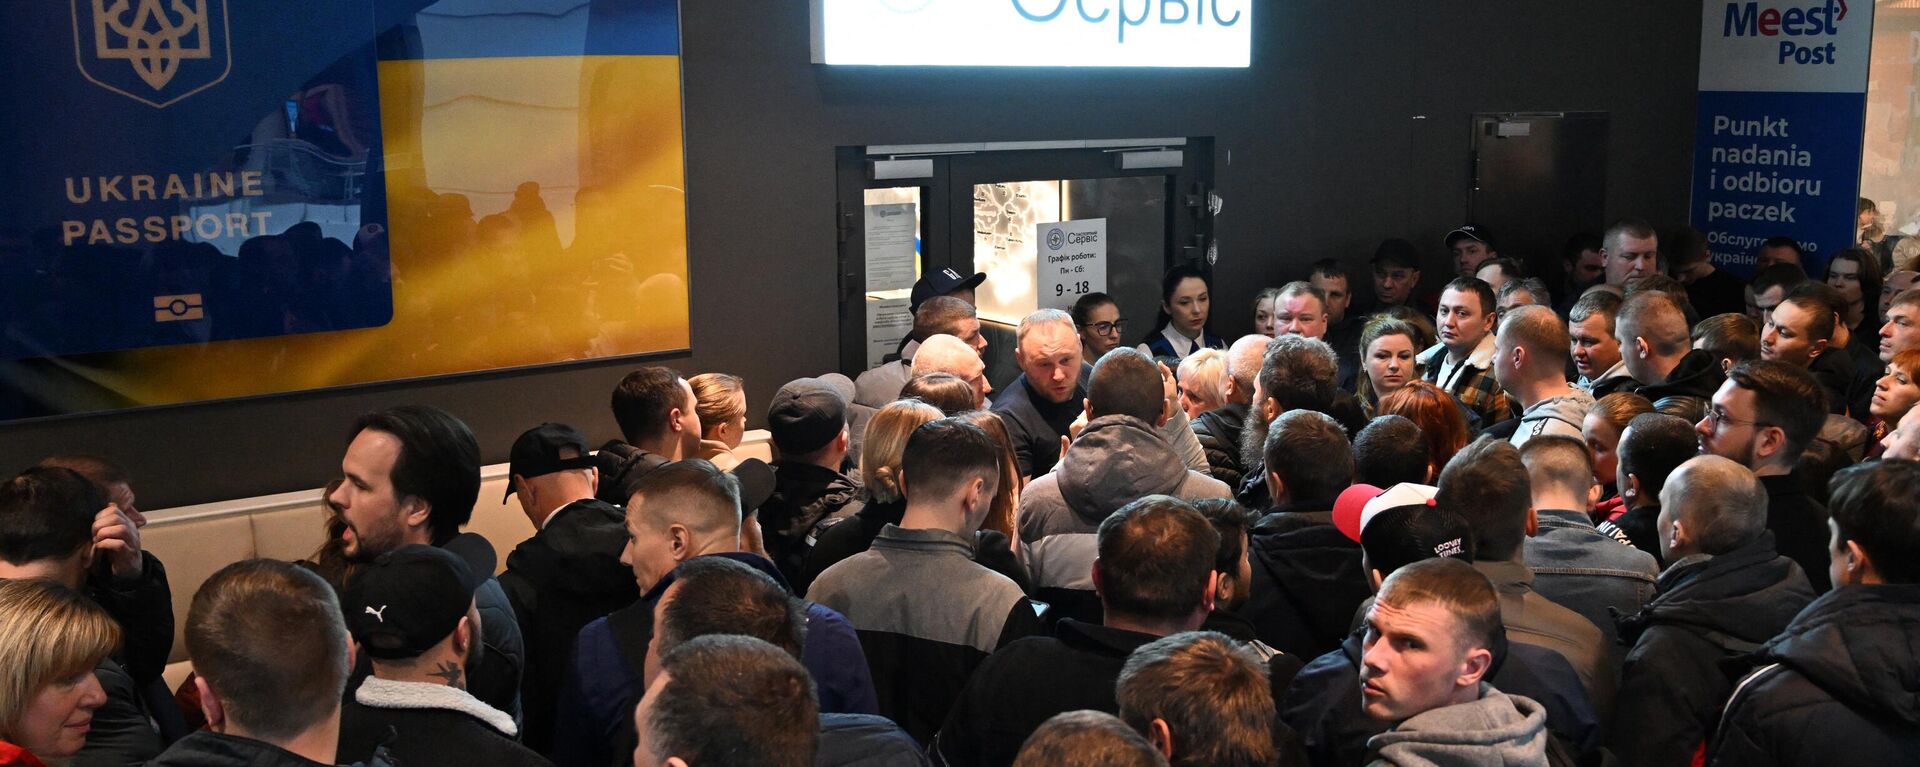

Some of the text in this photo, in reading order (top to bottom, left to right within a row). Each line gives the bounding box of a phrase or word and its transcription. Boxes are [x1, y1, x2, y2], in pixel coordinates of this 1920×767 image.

[1723, 0, 1839, 37] Meest
[1778, 41, 1836, 65] Post
[1713, 115, 1789, 138] Punkt
[1711, 143, 1812, 168] nadania
[65, 170, 265, 204] UKRAINE
[1709, 169, 1821, 197] i odbioru
[1708, 200, 1796, 223] paczek
[61, 211, 273, 246] PASSPORT
[1068, 232, 1098, 245] Сервіс
[1048, 253, 1096, 264] Графік роботи:
[1075, 265, 1084, 273] Сб:
[1056, 283, 1063, 297] 9
[1076, 281, 1089, 294] 18
